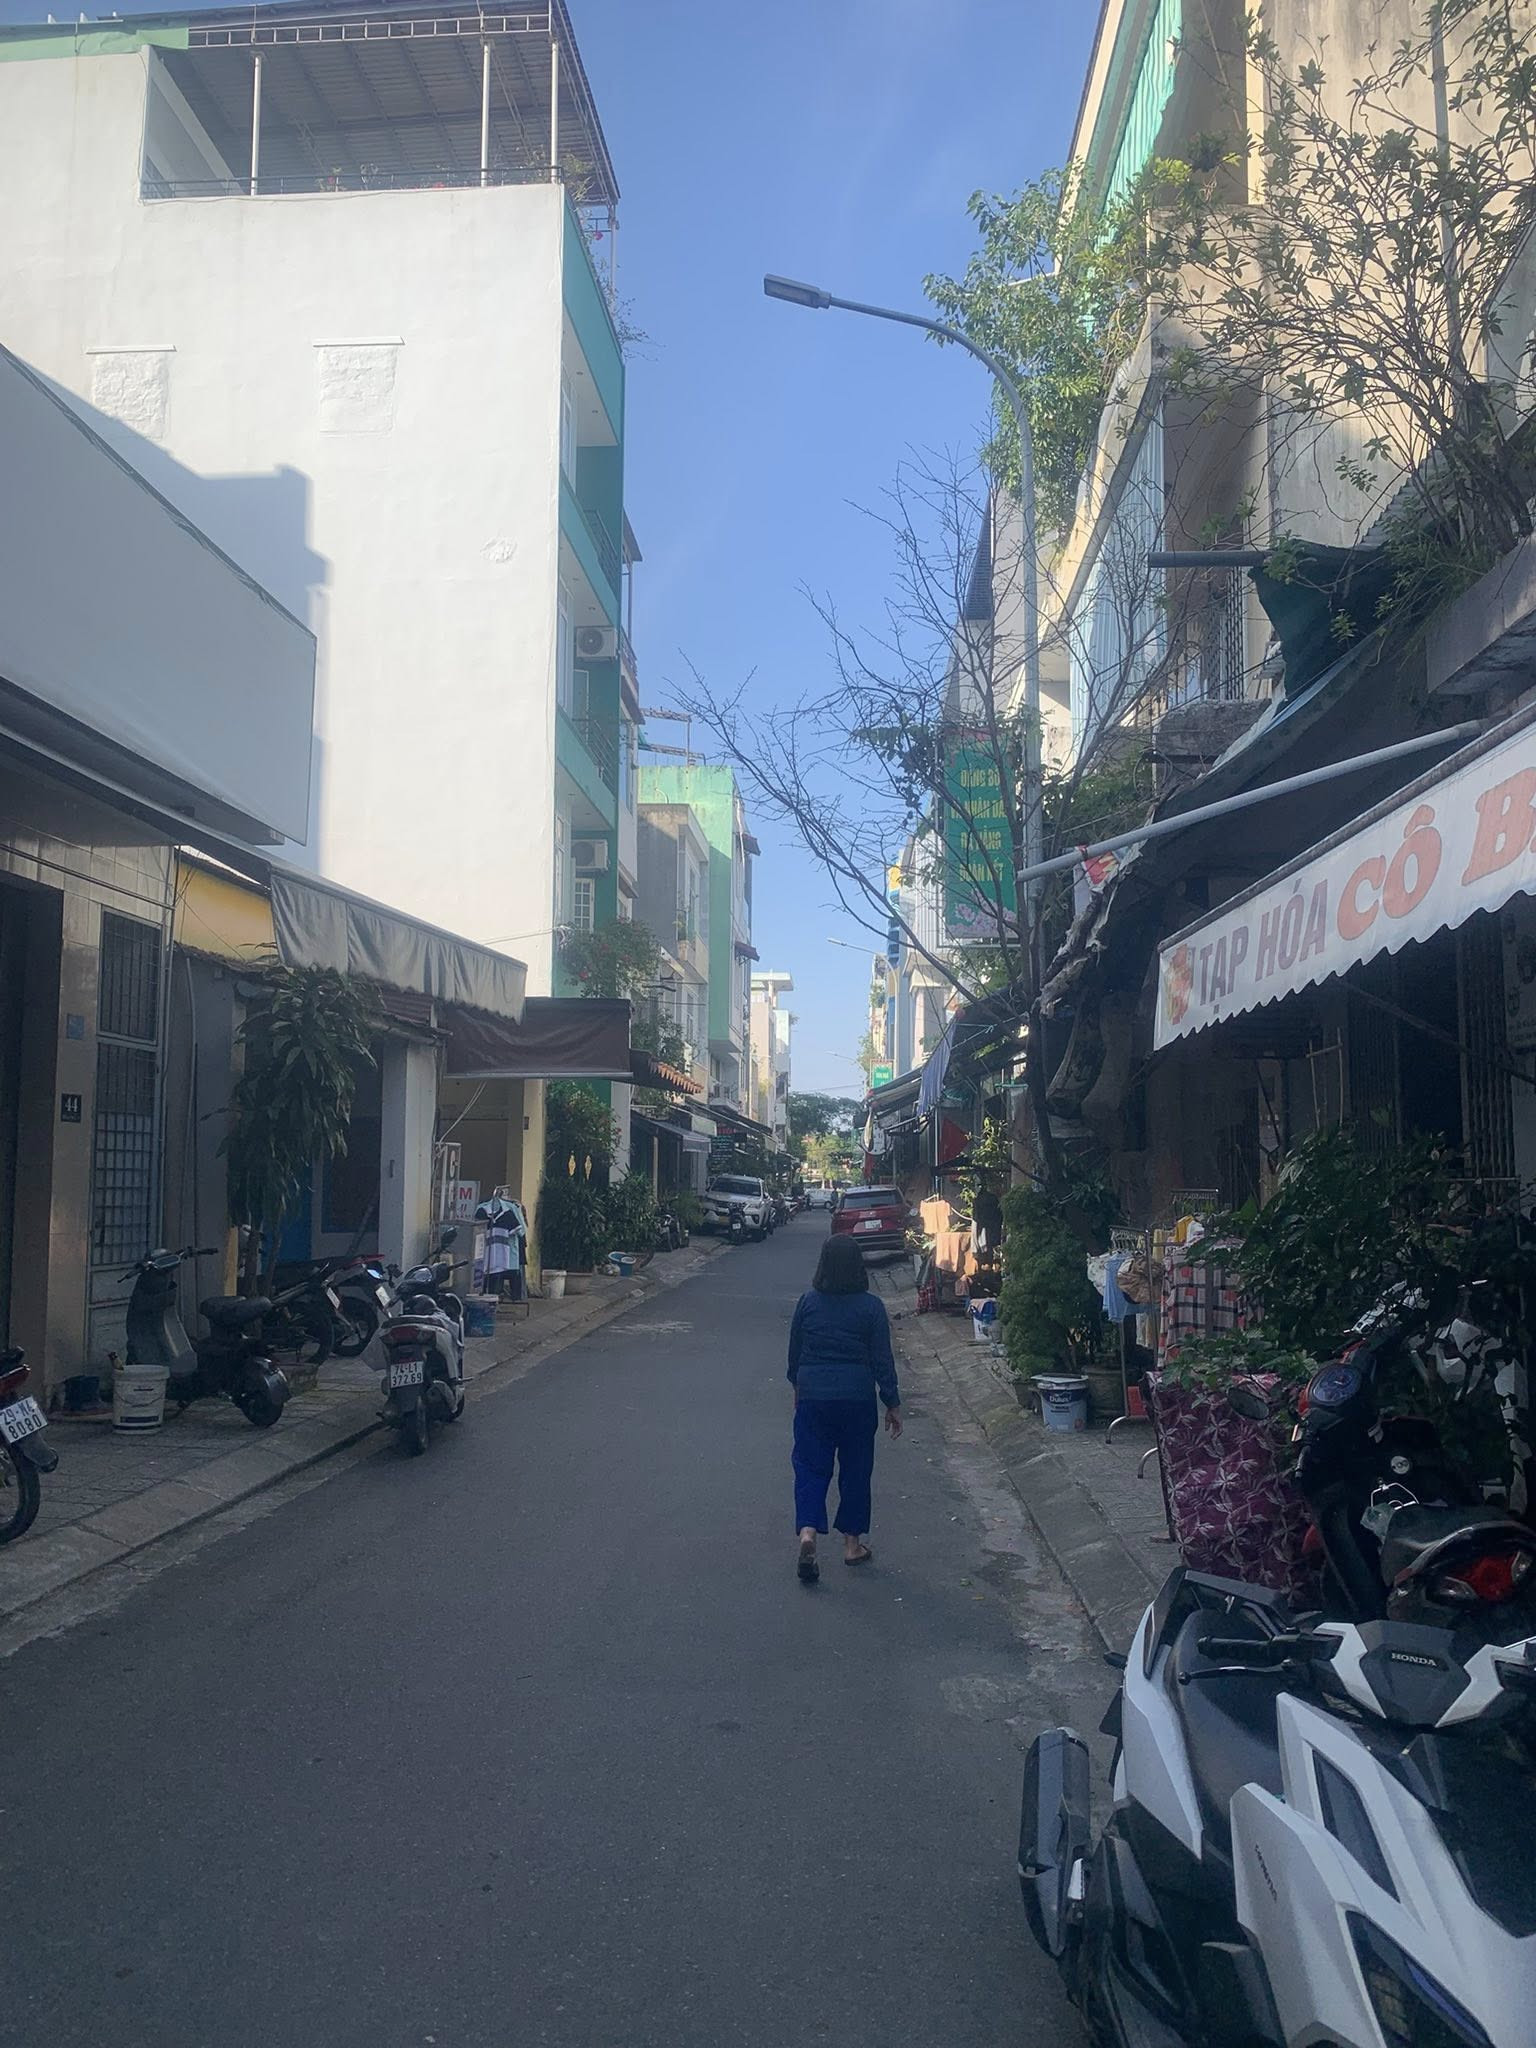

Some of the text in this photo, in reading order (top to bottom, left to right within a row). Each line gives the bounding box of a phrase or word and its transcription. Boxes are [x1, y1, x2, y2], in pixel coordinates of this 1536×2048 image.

[1199, 766, 1536, 1015] TẠP HÓA CÔ B
[65, 1097, 78, 1112] 44
[392, 1372, 421, 1387] 37269
[8, 1414, 42, 1439] 8080
[1391, 1652, 1438, 1667] HONDA
